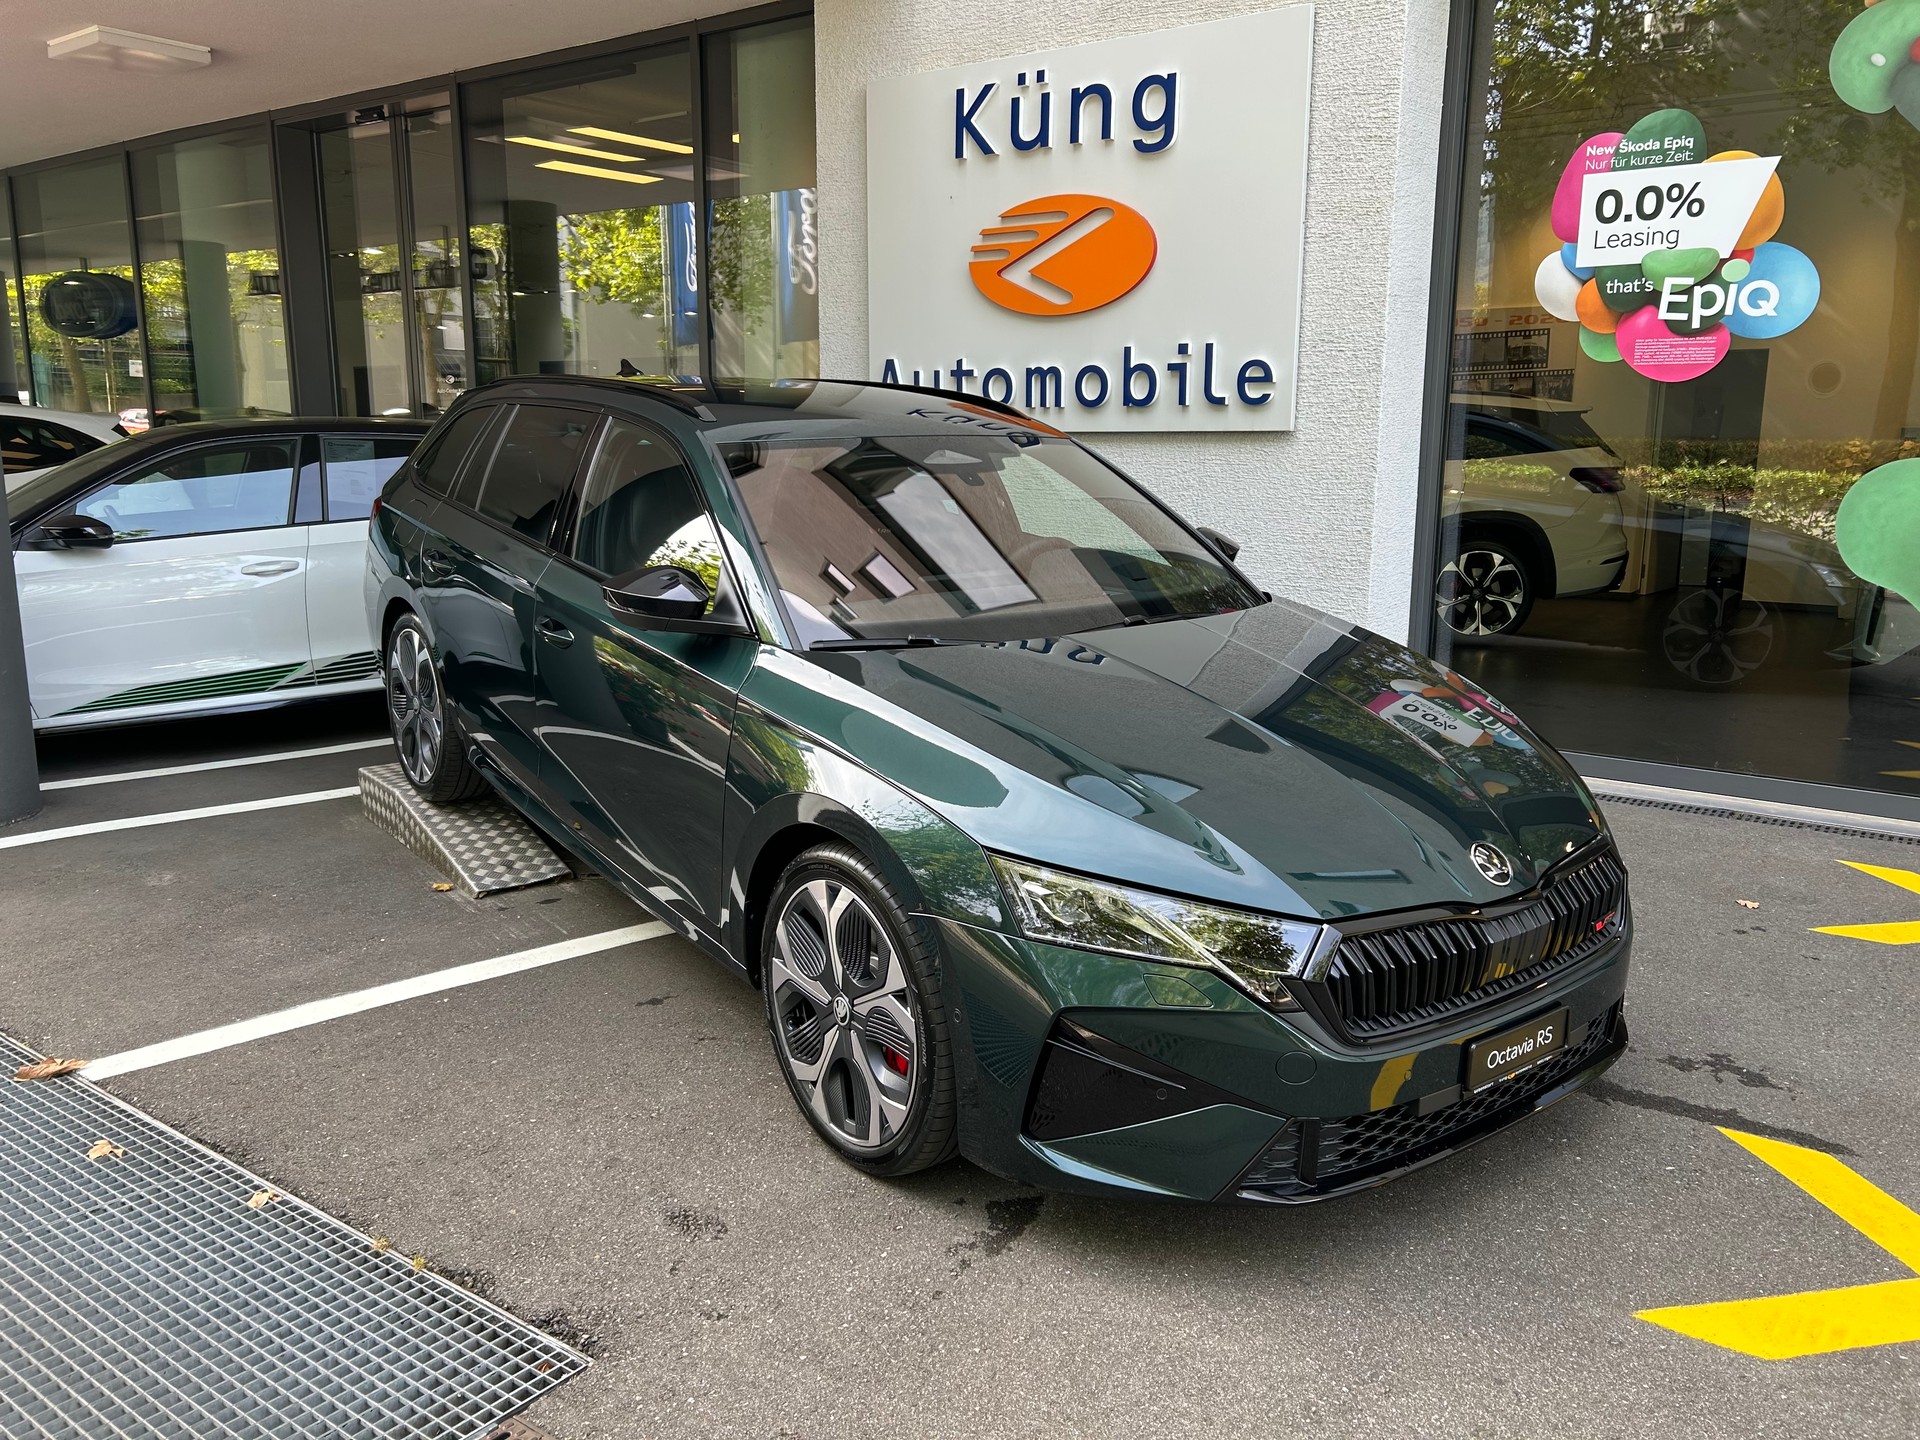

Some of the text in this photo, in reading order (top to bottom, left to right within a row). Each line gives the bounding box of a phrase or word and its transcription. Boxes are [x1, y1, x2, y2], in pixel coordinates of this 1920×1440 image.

[955, 69, 1179, 159] Küng
[1586, 135, 1695, 157] New Škoda Epiq
[1585, 150, 1694, 171] Nur für kurze Zeit:
[1595, 181, 1705, 224] 0.0%
[1594, 226, 1680, 250] Leasing
[1606, 277, 1654, 294] that’s
[1486, 1025, 1554, 1069] Octavia RS
